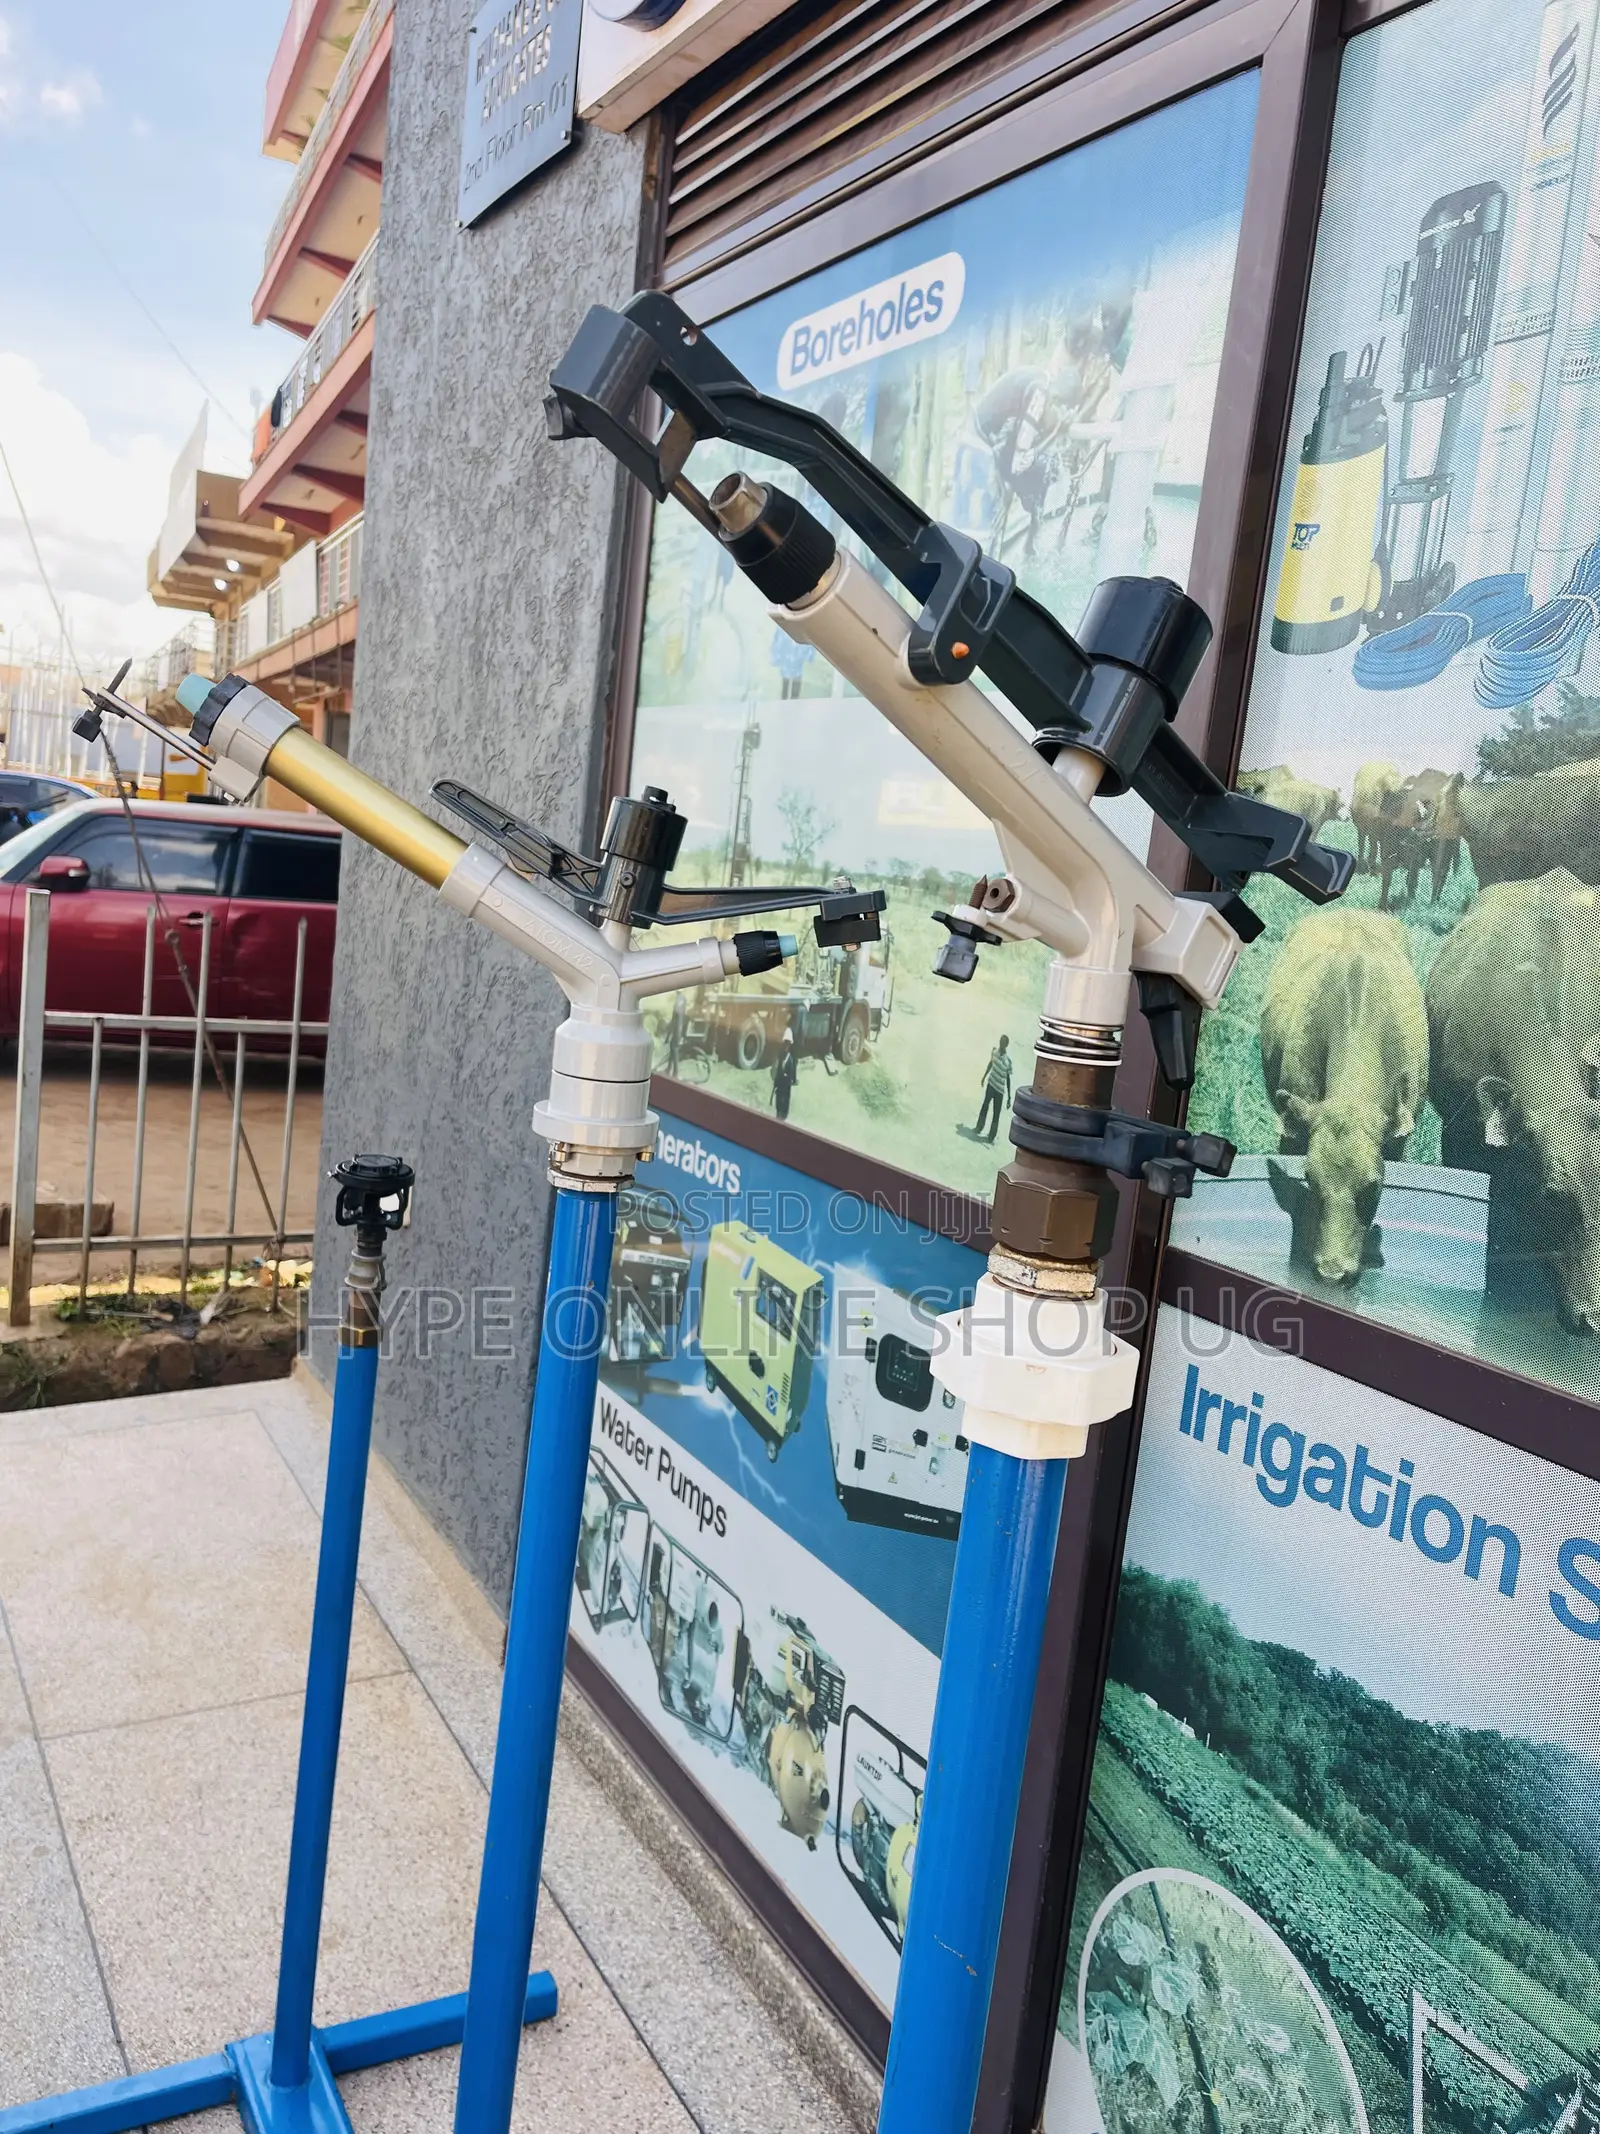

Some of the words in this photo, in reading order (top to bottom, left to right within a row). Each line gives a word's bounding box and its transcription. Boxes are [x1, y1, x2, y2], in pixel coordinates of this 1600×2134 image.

[485, 123, 519, 173] Floor
[519, 100, 547, 142] Rm
[548, 73, 568, 119] 01
[790, 279, 944, 377] Boreholes
[1293, 522, 1321, 542] TOP
[600, 1396, 655, 1471] Water
[657, 1446, 728, 1538] Pumps
[1179, 1364, 1522, 1599] Irrigation
